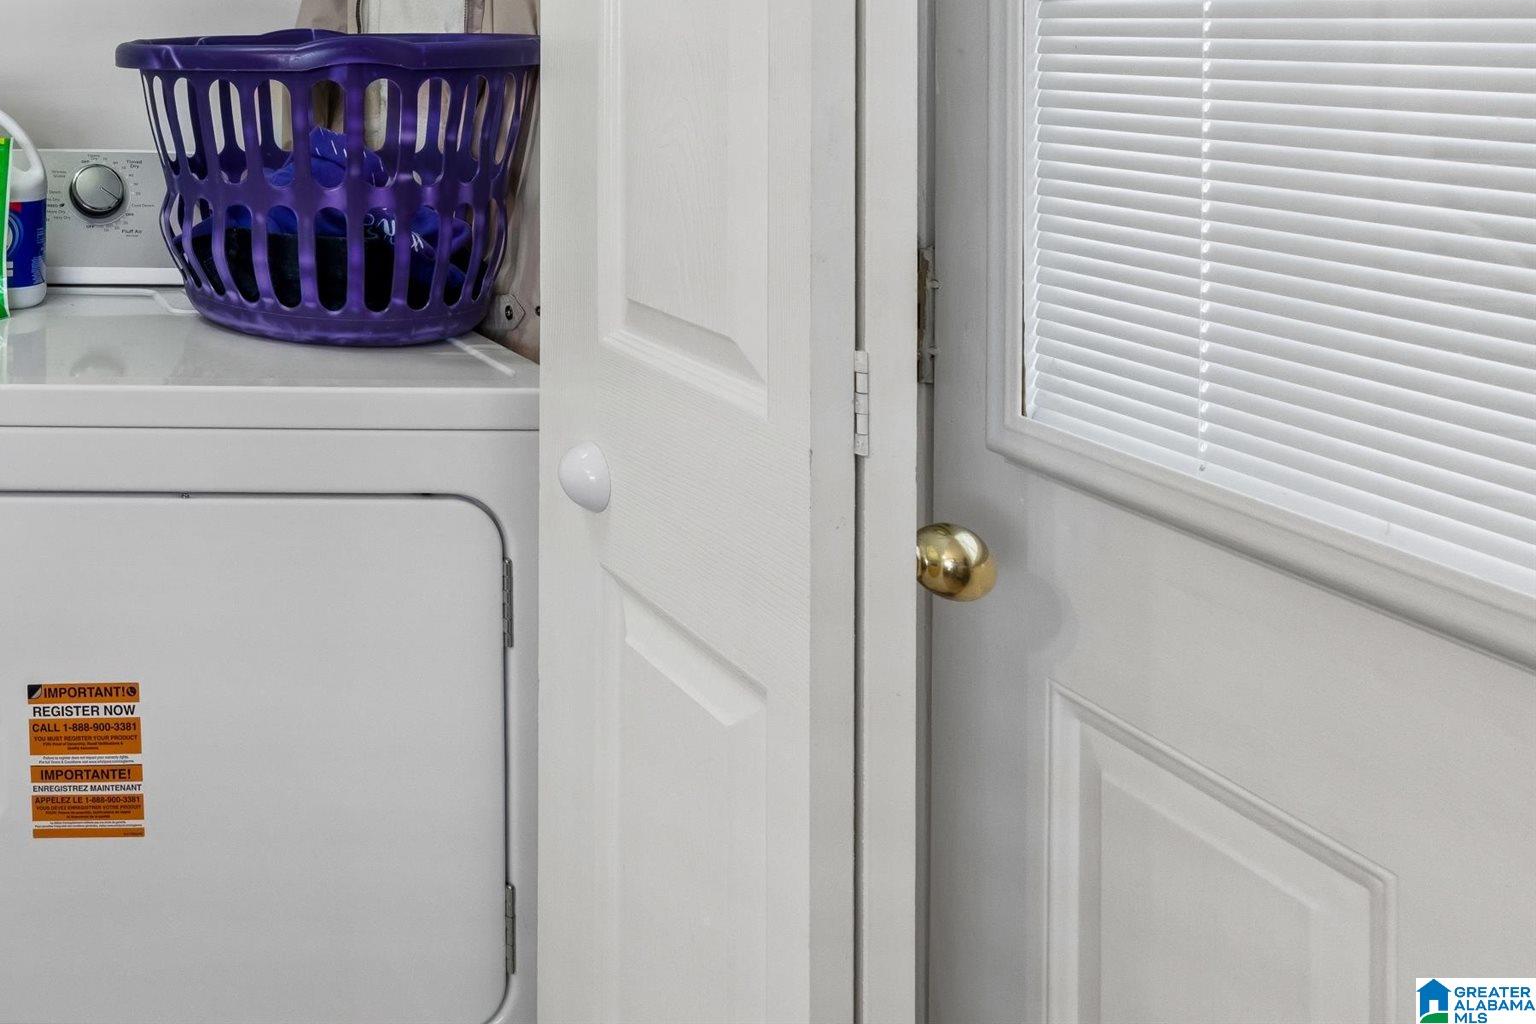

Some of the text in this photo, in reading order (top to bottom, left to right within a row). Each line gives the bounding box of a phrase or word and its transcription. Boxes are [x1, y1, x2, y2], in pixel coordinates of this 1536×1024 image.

[44, 686, 126, 698] IMPORTANT!
[32, 704, 136, 718] REGISTER NOW
[32, 722, 137, 732] CALL 1-888-900-3381
[40, 768, 131, 781] IMPORTANTE!
[32, 784, 142, 793] ENREGISTREZ MAINTENANT
[34, 796, 72, 804] APPELEZ
[72, 796, 84, 804] LE
